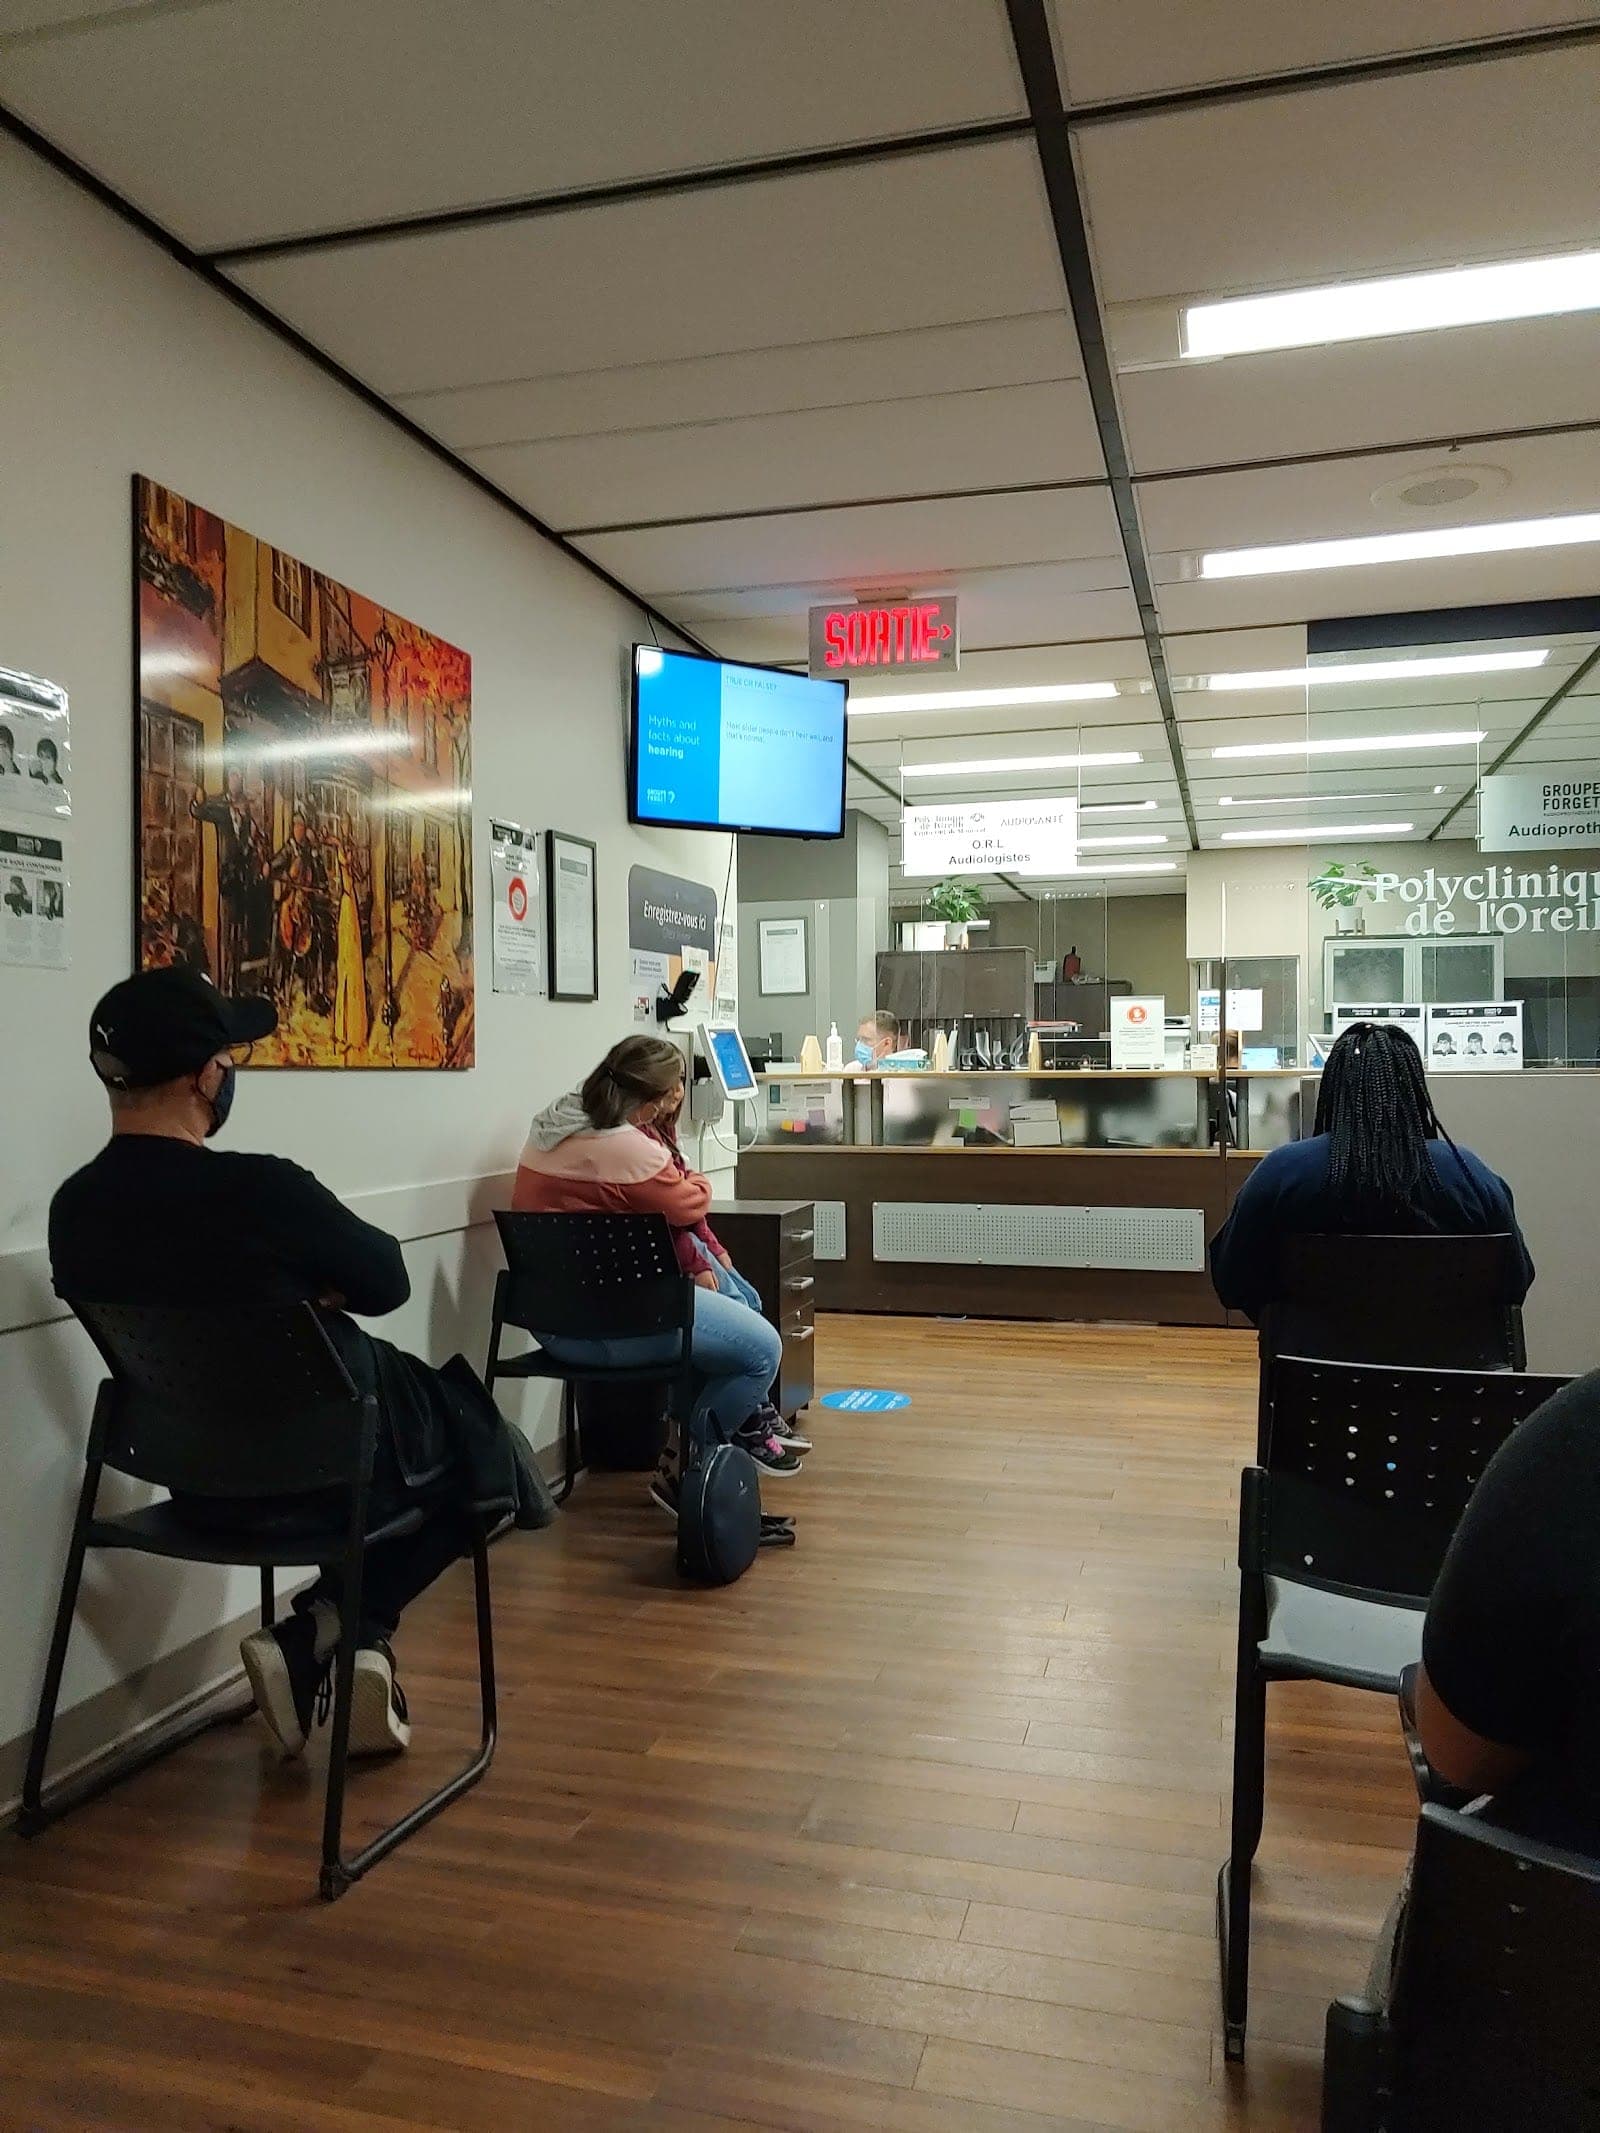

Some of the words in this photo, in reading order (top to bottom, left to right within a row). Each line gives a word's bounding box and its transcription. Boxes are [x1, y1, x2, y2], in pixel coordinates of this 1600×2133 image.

[825, 604, 940, 668] SORTIE
[648, 714, 676, 728] Myths
[679, 719, 697, 731] and
[673, 733, 700, 745] about
[648, 743, 684, 759] hearing
[1543, 783, 1600, 797] GROUPE
[1543, 796, 1600, 810] FORGET
[949, 853, 1031, 865] Audiologistes
[644, 900, 699, 928] Enregistrez-vous
[1405, 903, 1455, 936] de
